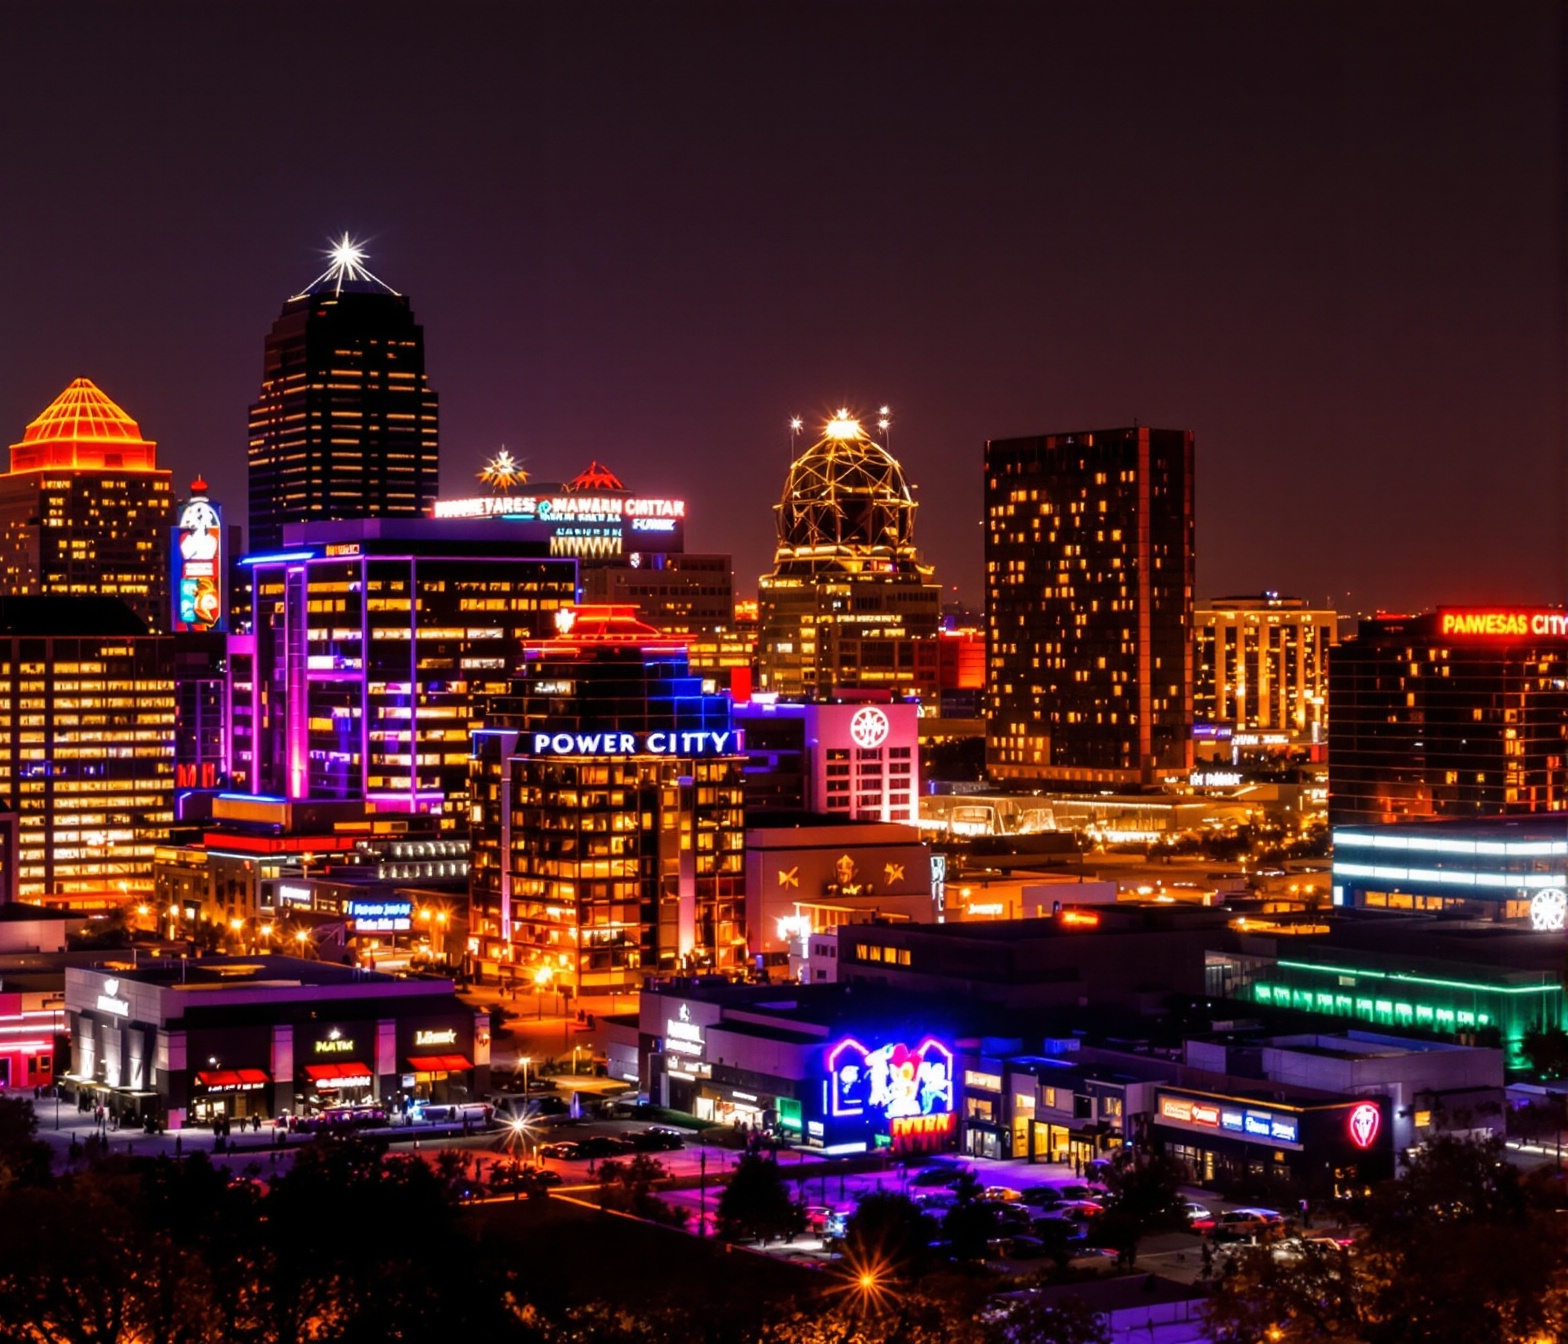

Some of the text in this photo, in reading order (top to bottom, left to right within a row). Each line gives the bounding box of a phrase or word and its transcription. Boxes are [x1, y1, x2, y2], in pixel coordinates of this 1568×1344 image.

[1529, 614, 1568, 635] CITY
[534, 731, 730, 754] POWER CITTY
